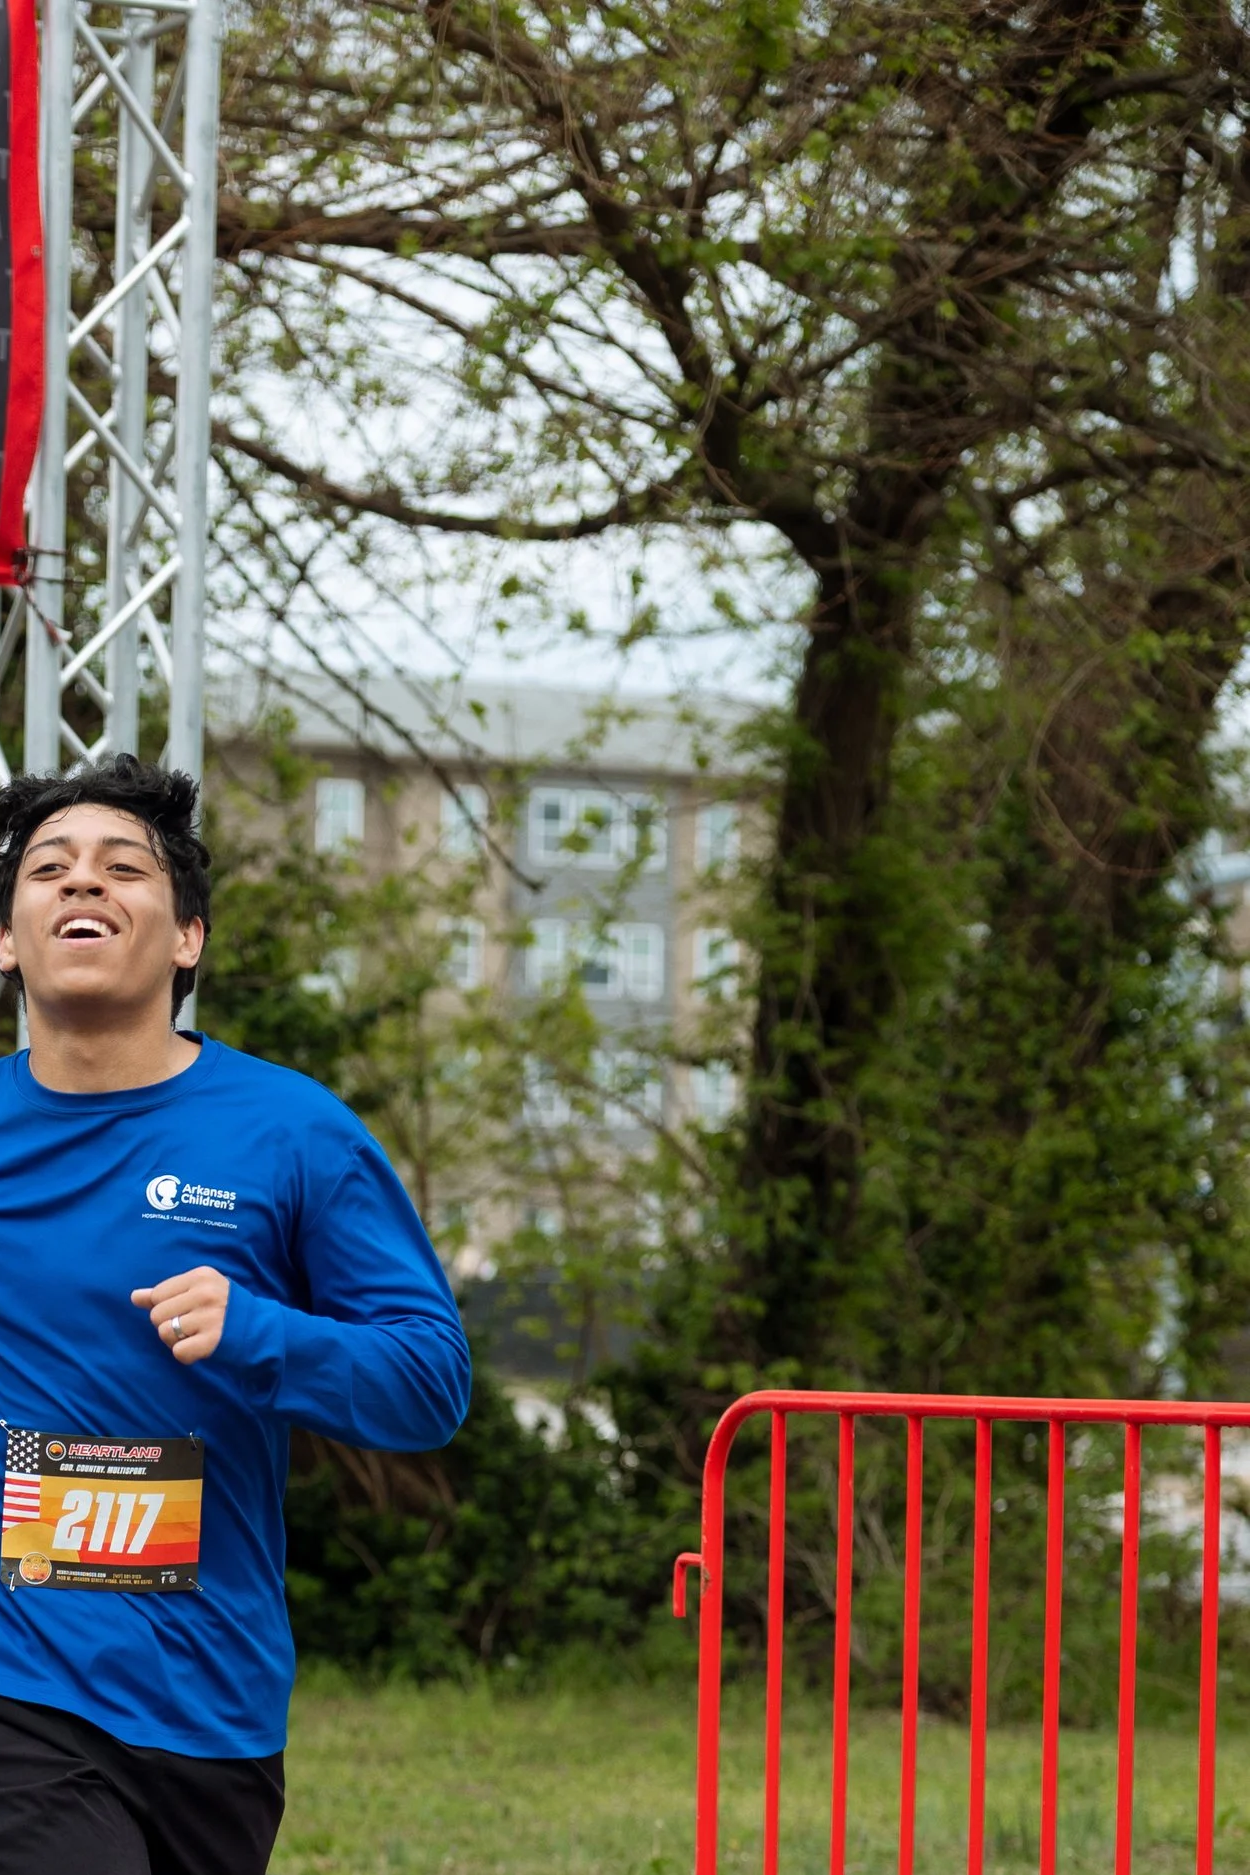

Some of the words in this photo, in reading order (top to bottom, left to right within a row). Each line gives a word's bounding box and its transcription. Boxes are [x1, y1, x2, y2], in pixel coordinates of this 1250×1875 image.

[182, 1183, 237, 1201] Arkansas
[180, 1193, 235, 1211] Children's
[68, 1443, 162, 1459] HEARTLAND
[52, 1489, 166, 1555] 2117
